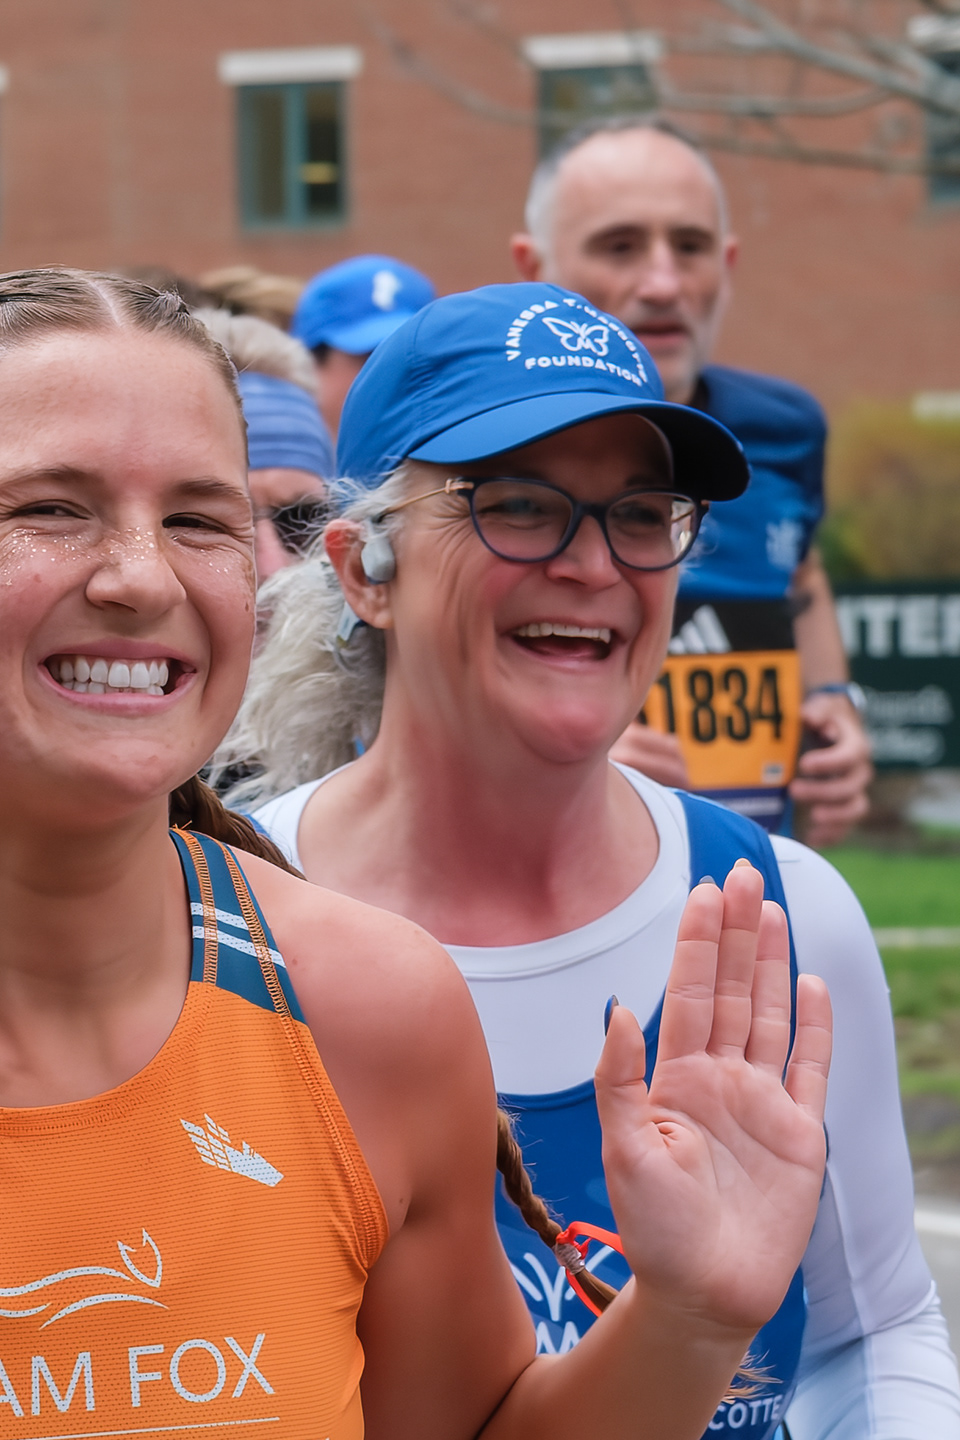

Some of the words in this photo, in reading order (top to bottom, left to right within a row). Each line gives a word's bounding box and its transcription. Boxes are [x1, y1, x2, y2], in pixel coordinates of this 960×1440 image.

[525, 355, 643, 387] FOUNDATION
[639, 667, 783, 743] 1834
[127, 1332, 275, 1407] FOX
